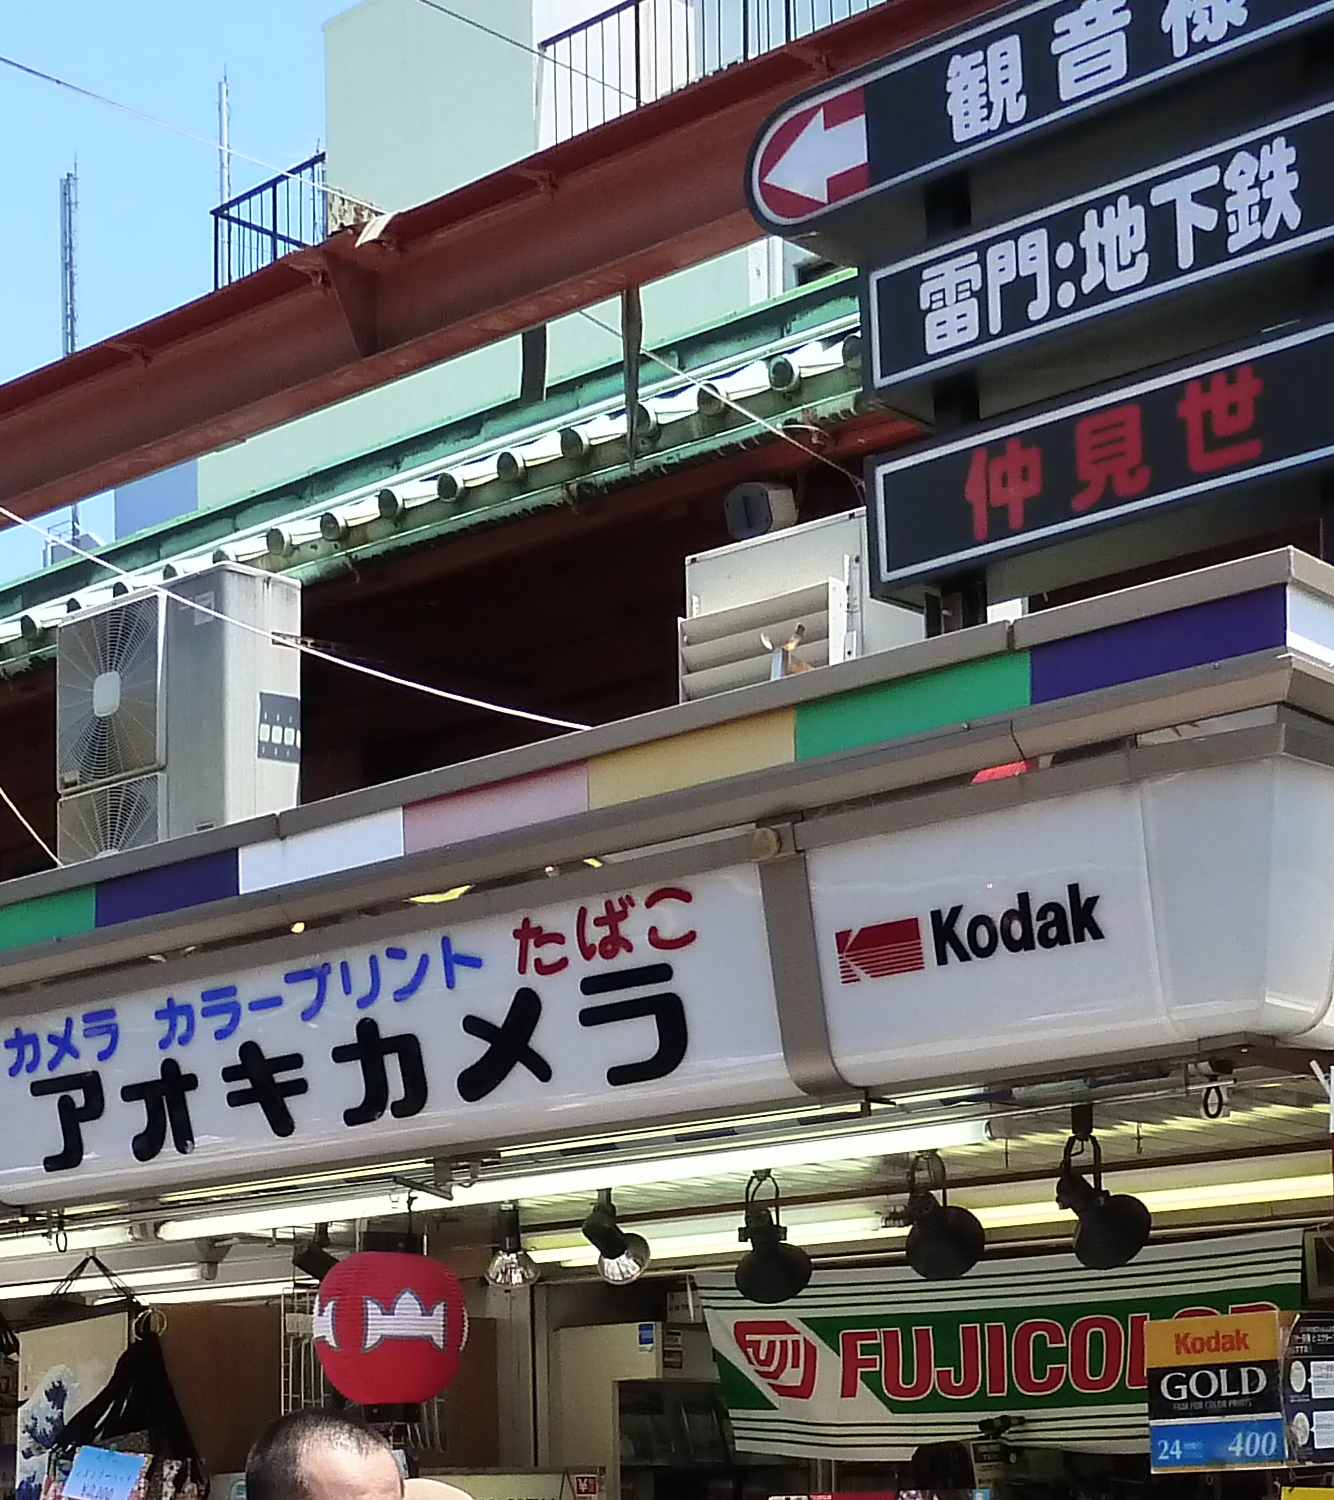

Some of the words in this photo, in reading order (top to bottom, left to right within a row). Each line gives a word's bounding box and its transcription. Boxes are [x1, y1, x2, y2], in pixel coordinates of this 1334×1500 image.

[963, 362, 1266, 542] 仲見世
[930, 881, 1105, 967] Kodak
[3, 1007, 120, 1078] カメラ
[154, 934, 483, 1052] カラープリント
[513, 886, 697, 976] たばこ
[29, 963, 690, 1173] アオキカメラ
[1173, 1327, 1251, 1356] Kodak
[1160, 1365, 1268, 1401] GOLD
[1156, 1439, 1183, 1460] 24
[1227, 1430, 1278, 1459] 400
